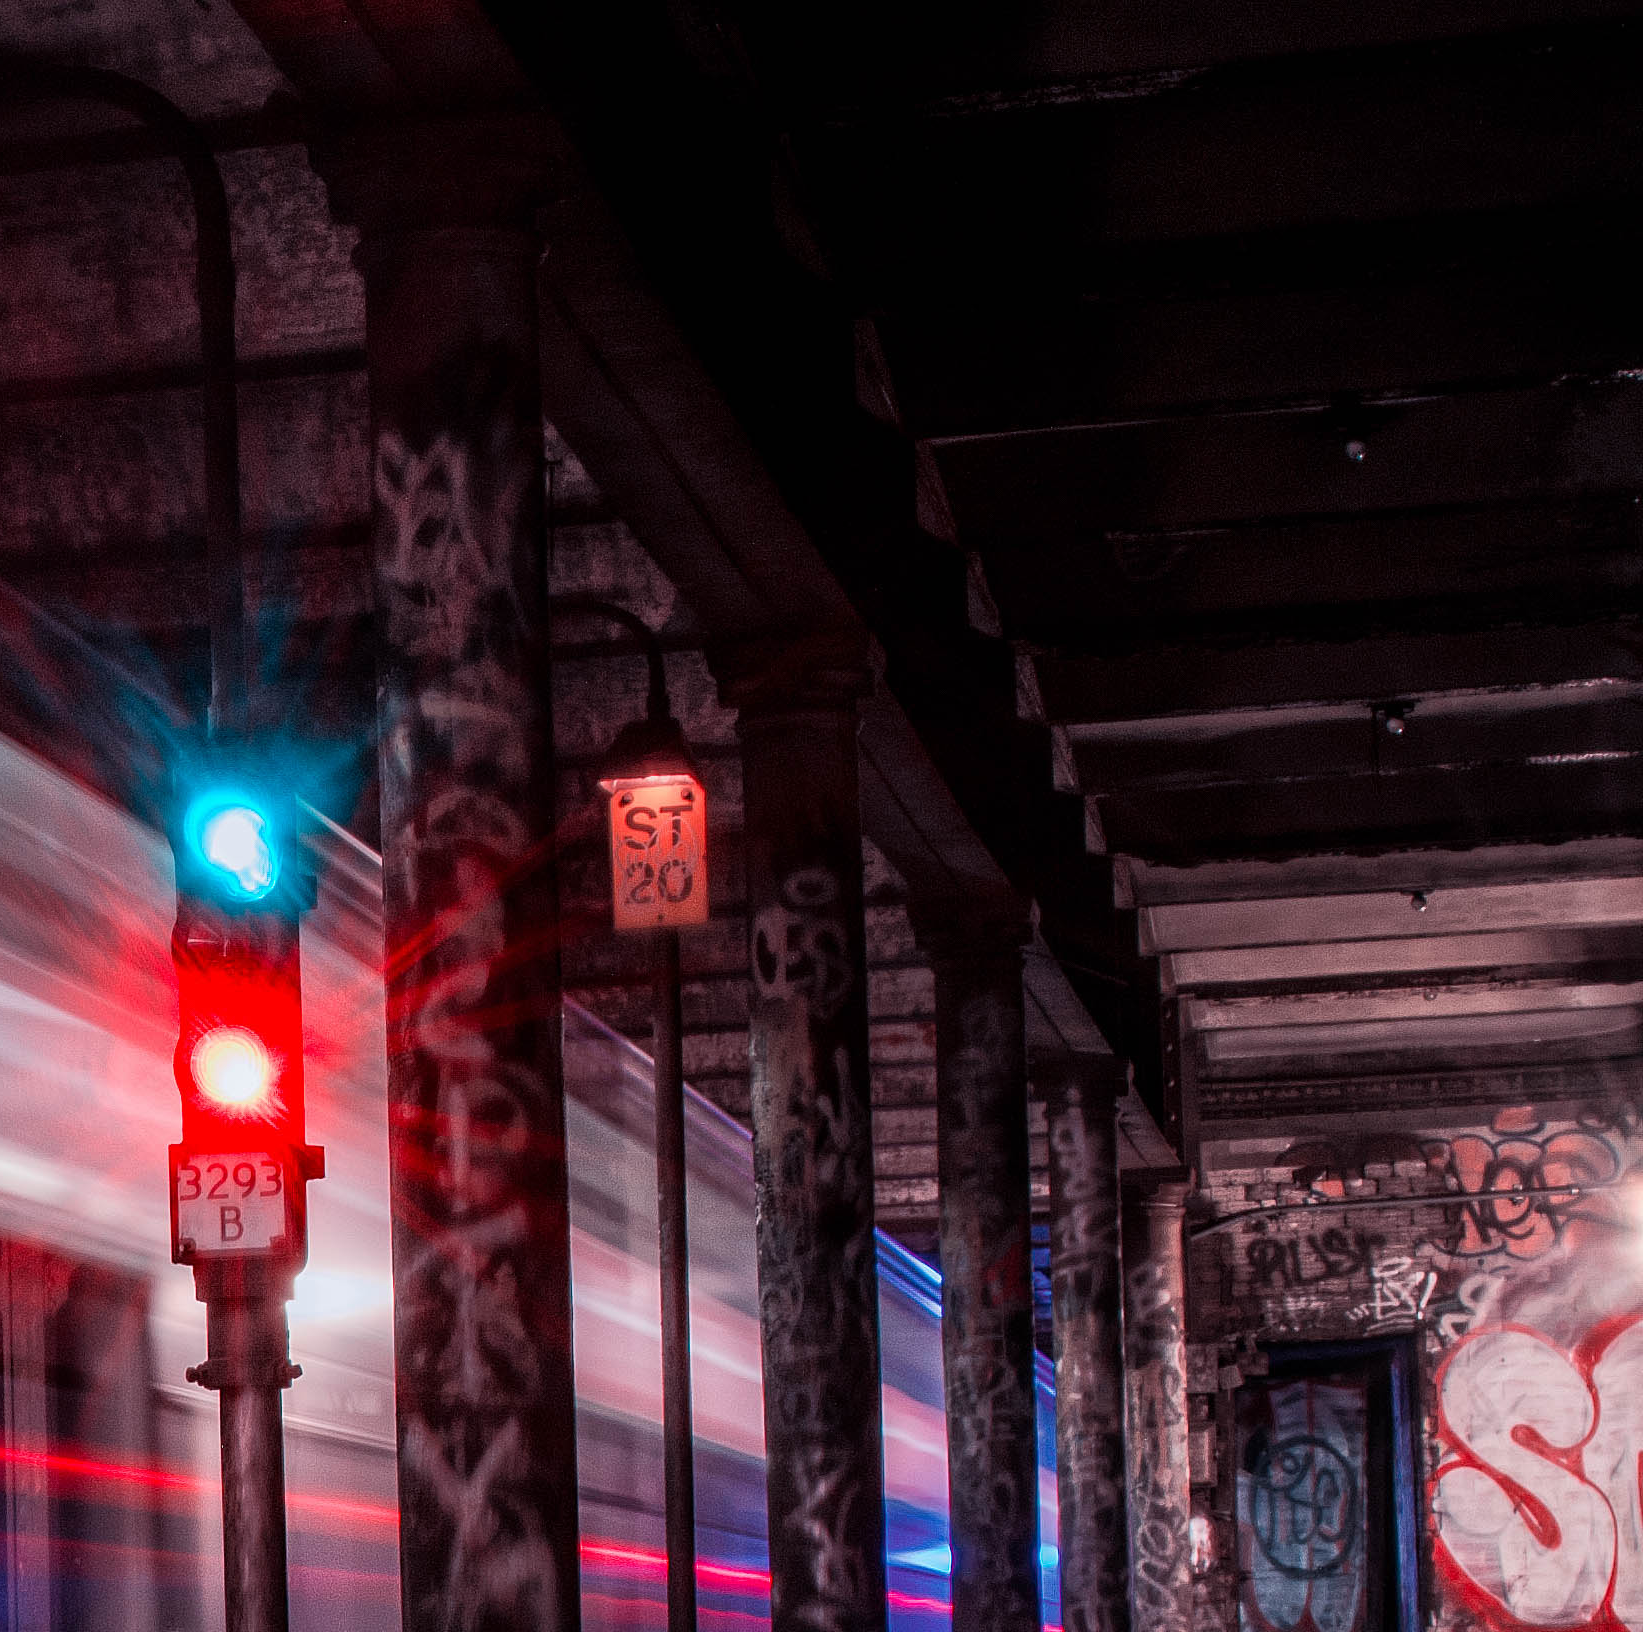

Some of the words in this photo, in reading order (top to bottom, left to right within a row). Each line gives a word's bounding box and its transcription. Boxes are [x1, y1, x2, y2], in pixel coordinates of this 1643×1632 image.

[624, 805, 693, 850] ST
[625, 859, 693, 903] 20
[178, 1160, 283, 1201] 3293
[219, 1205, 244, 1242] B
